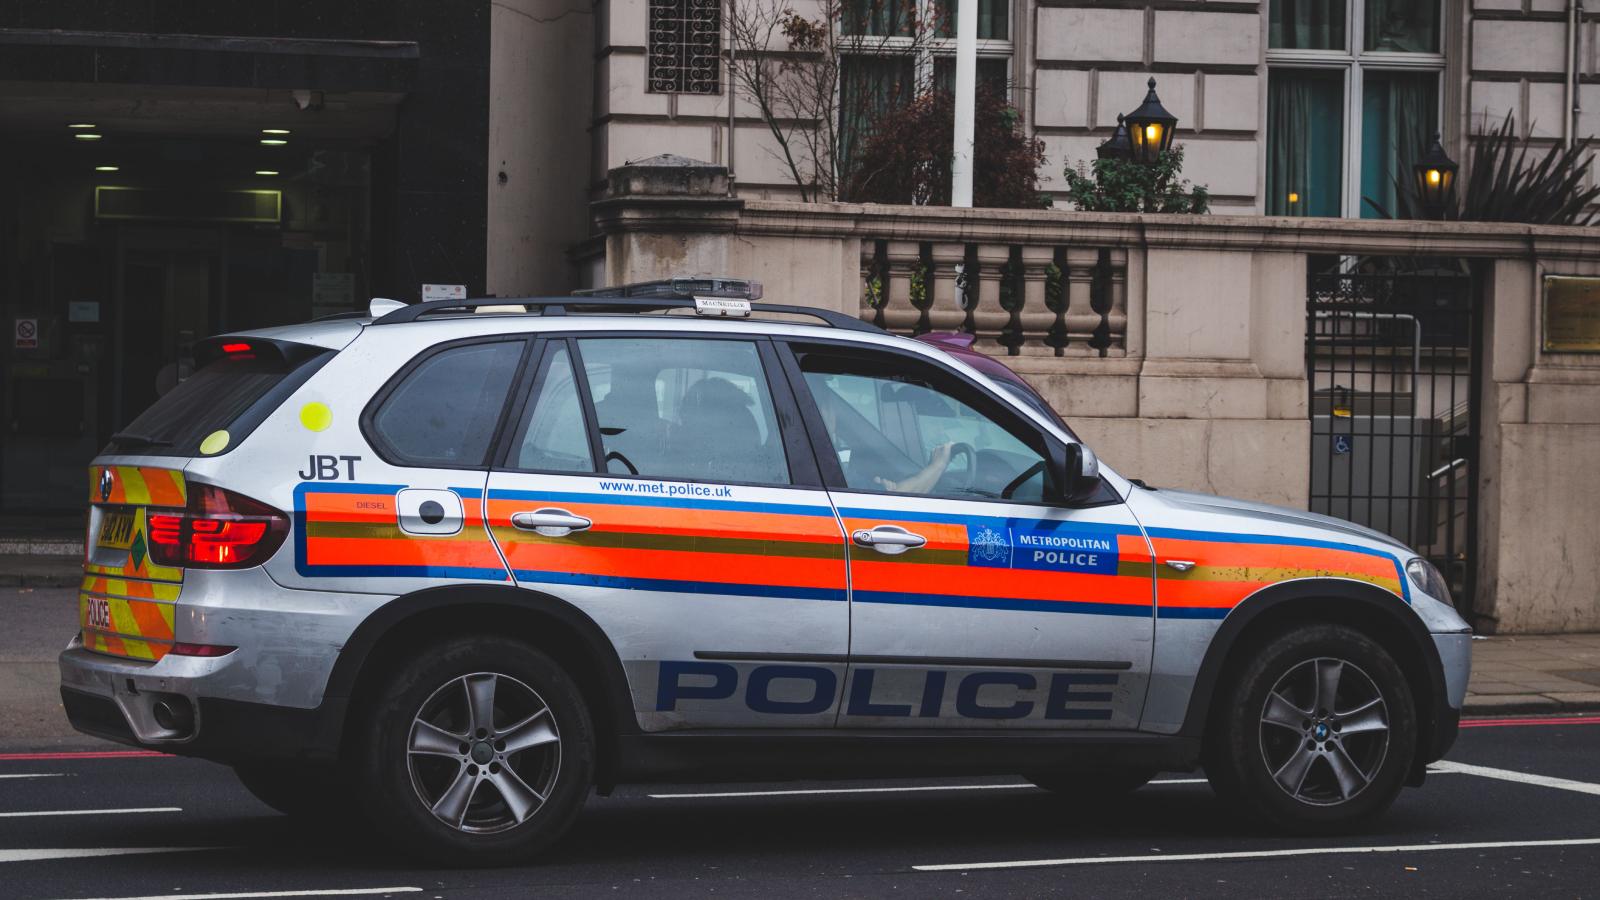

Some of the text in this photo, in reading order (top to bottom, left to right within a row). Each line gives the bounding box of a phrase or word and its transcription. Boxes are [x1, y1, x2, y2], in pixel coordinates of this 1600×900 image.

[298, 455, 362, 481] JBT
[599, 481, 732, 497] www.met.police.uk
[356, 501, 387, 510] DIESEL
[1019, 534, 1110, 550] METROPOLITAN
[1033, 550, 1098, 566] POLICE
[655, 660, 1119, 720] POLICE
